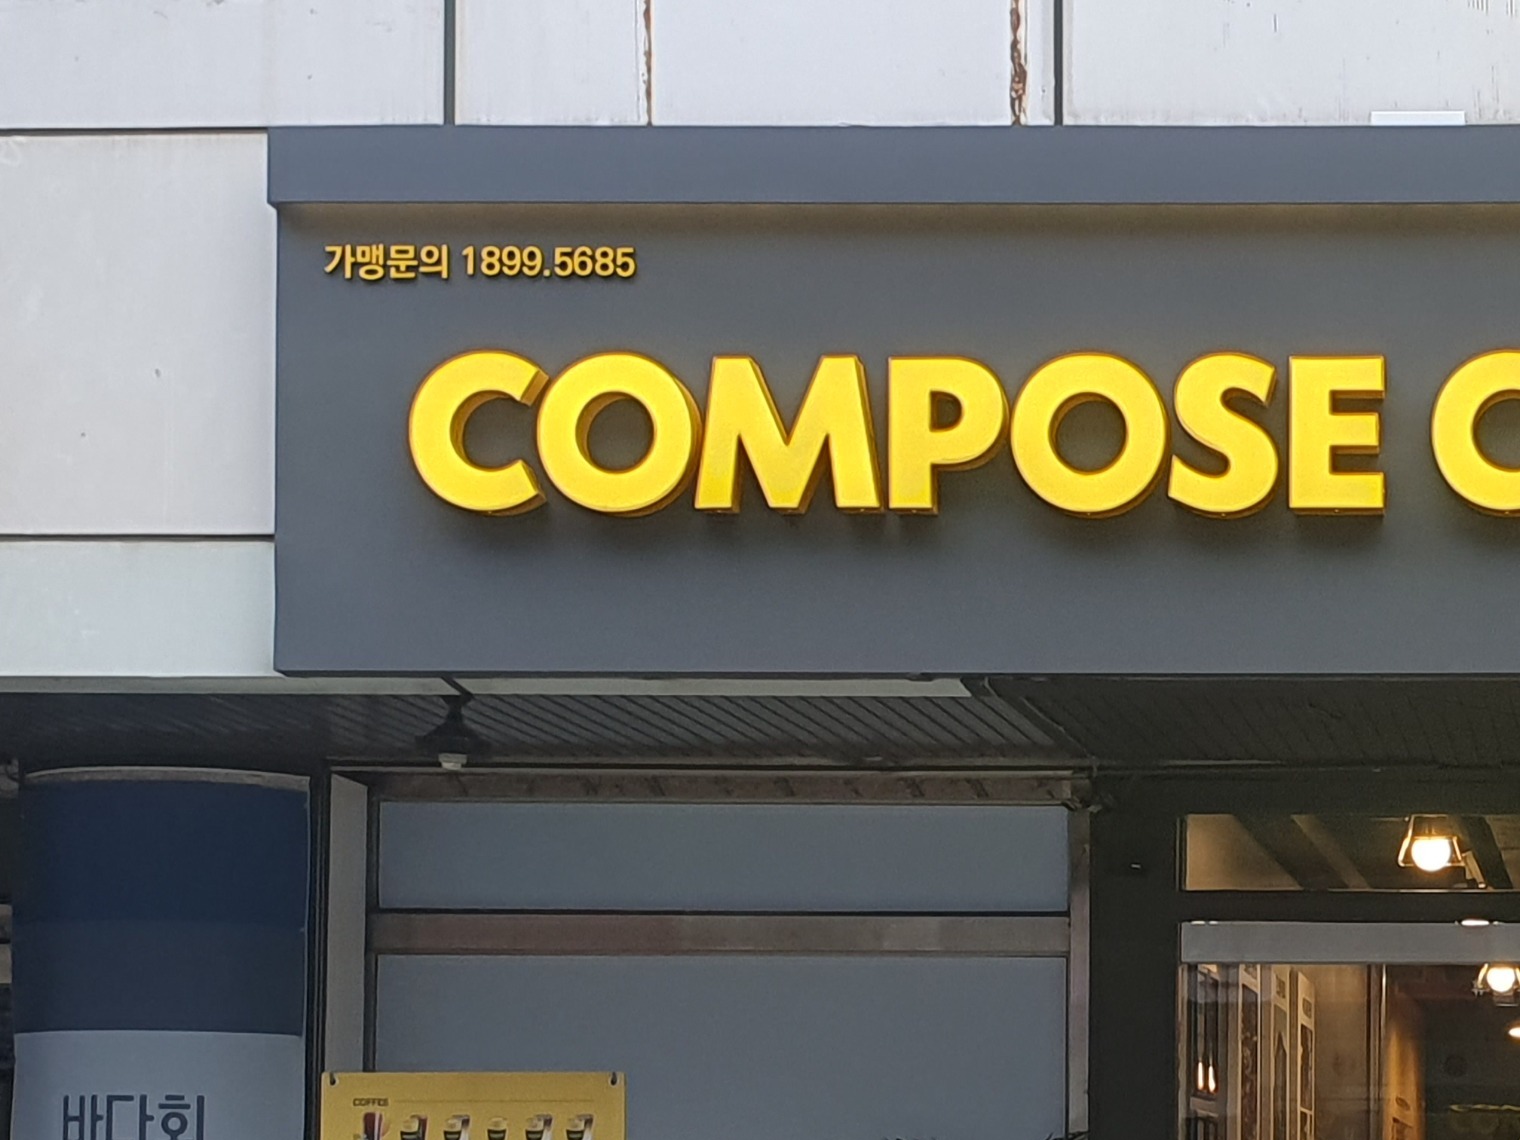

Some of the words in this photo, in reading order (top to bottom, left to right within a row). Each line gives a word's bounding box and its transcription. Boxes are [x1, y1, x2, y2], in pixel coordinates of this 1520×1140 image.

[324, 243, 450, 280] 가맹문의
[461, 245, 637, 278] 1899.5685
[408, 348, 1388, 516] COMPOSE
[352, 1097, 389, 1107] COFFEE
